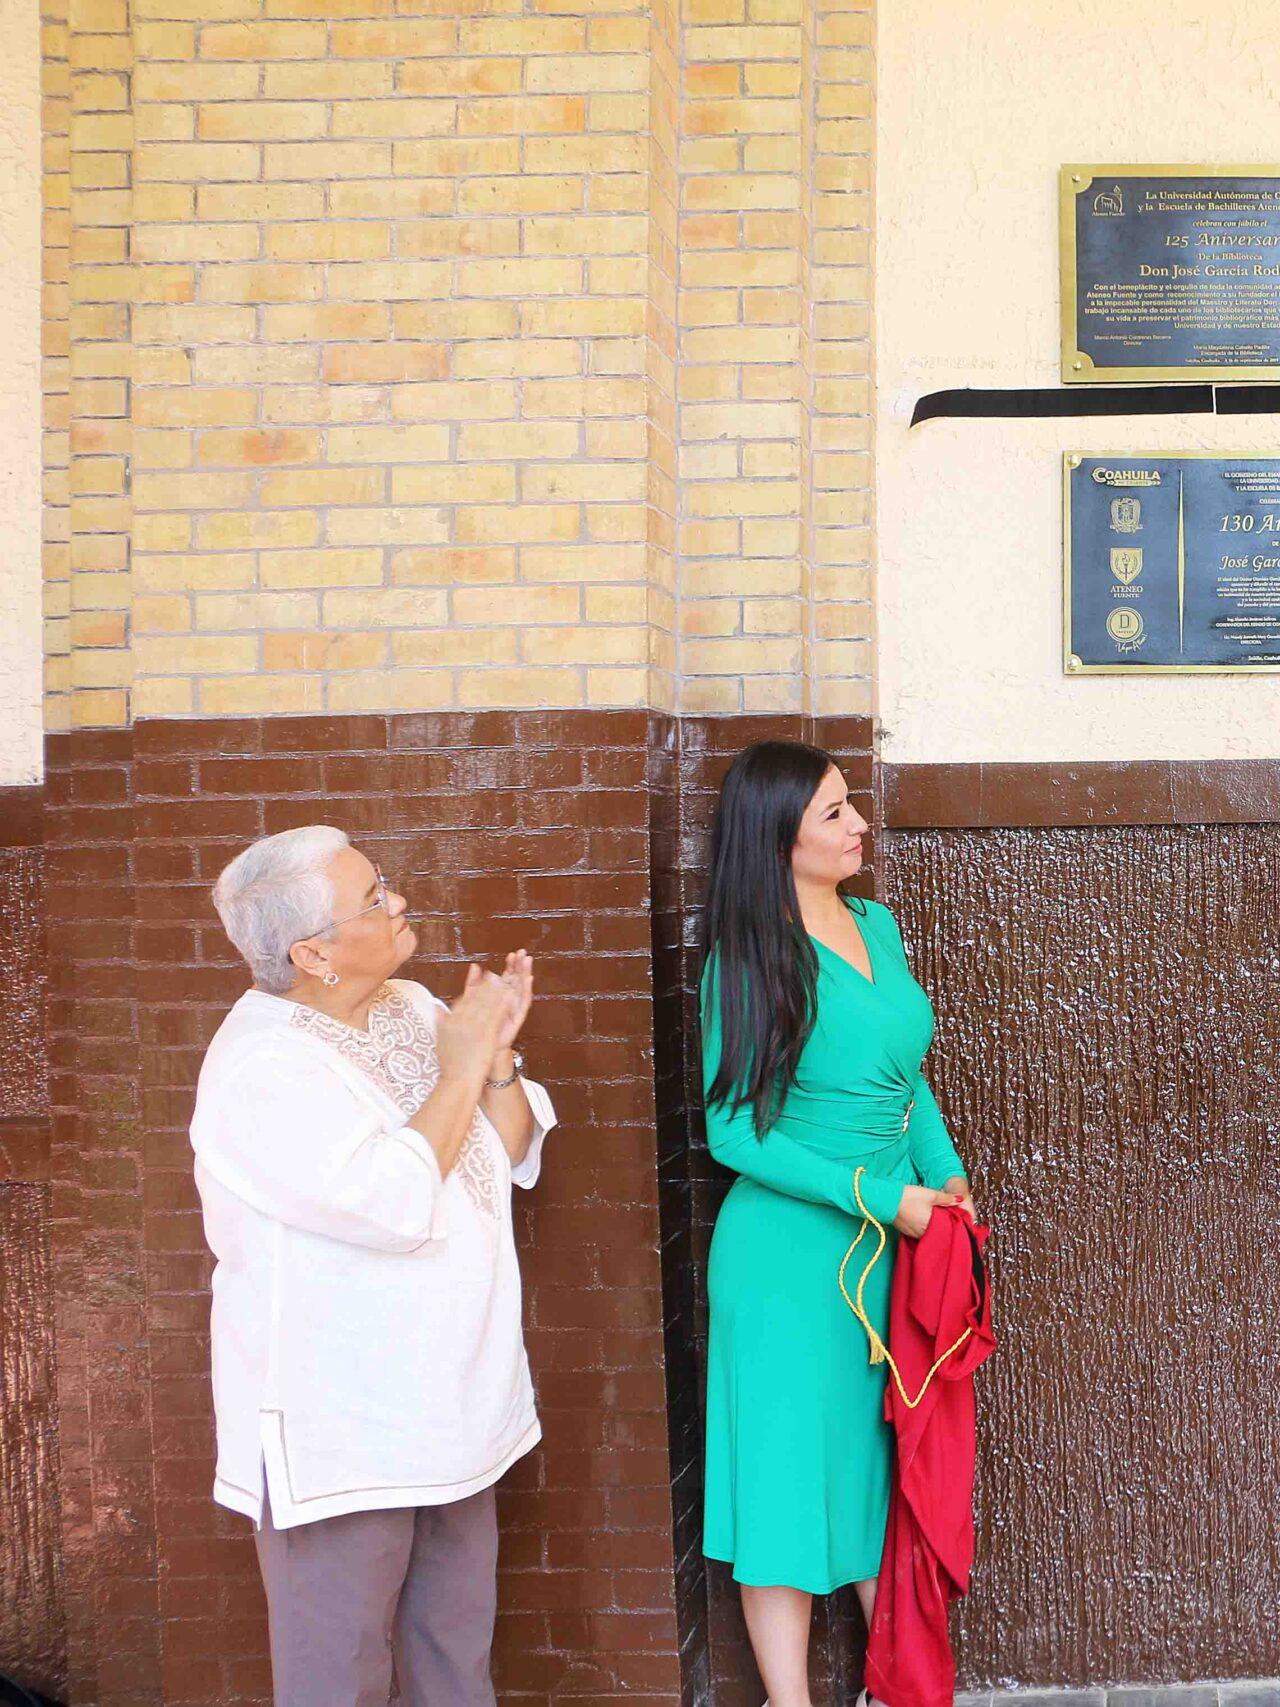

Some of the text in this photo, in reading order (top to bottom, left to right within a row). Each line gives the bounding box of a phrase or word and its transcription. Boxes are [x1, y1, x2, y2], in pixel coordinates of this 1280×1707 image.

[1145, 191, 1157, 200] La
[1159, 191, 1212, 200] Universidad
[1215, 190, 1260, 200] Autónoma
[1262, 191, 1272, 200] de
[1138, 204, 1143, 213] y
[1145, 203, 1153, 211] la
[1158, 203, 1193, 211] Escuela
[1195, 203, 1205, 211] de
[1208, 203, 1256, 211] Bachilleres
[1165, 234, 1189, 248] 125
[1139, 264, 1170, 277] Don
[1171, 263, 1200, 279] José
[1205, 263, 1248, 277] García
[1092, 466, 1161, 483] COAHUILA
[1219, 514, 1254, 532] 130
[1219, 555, 1248, 570] José
[1110, 585, 1143, 593] ATENEO
